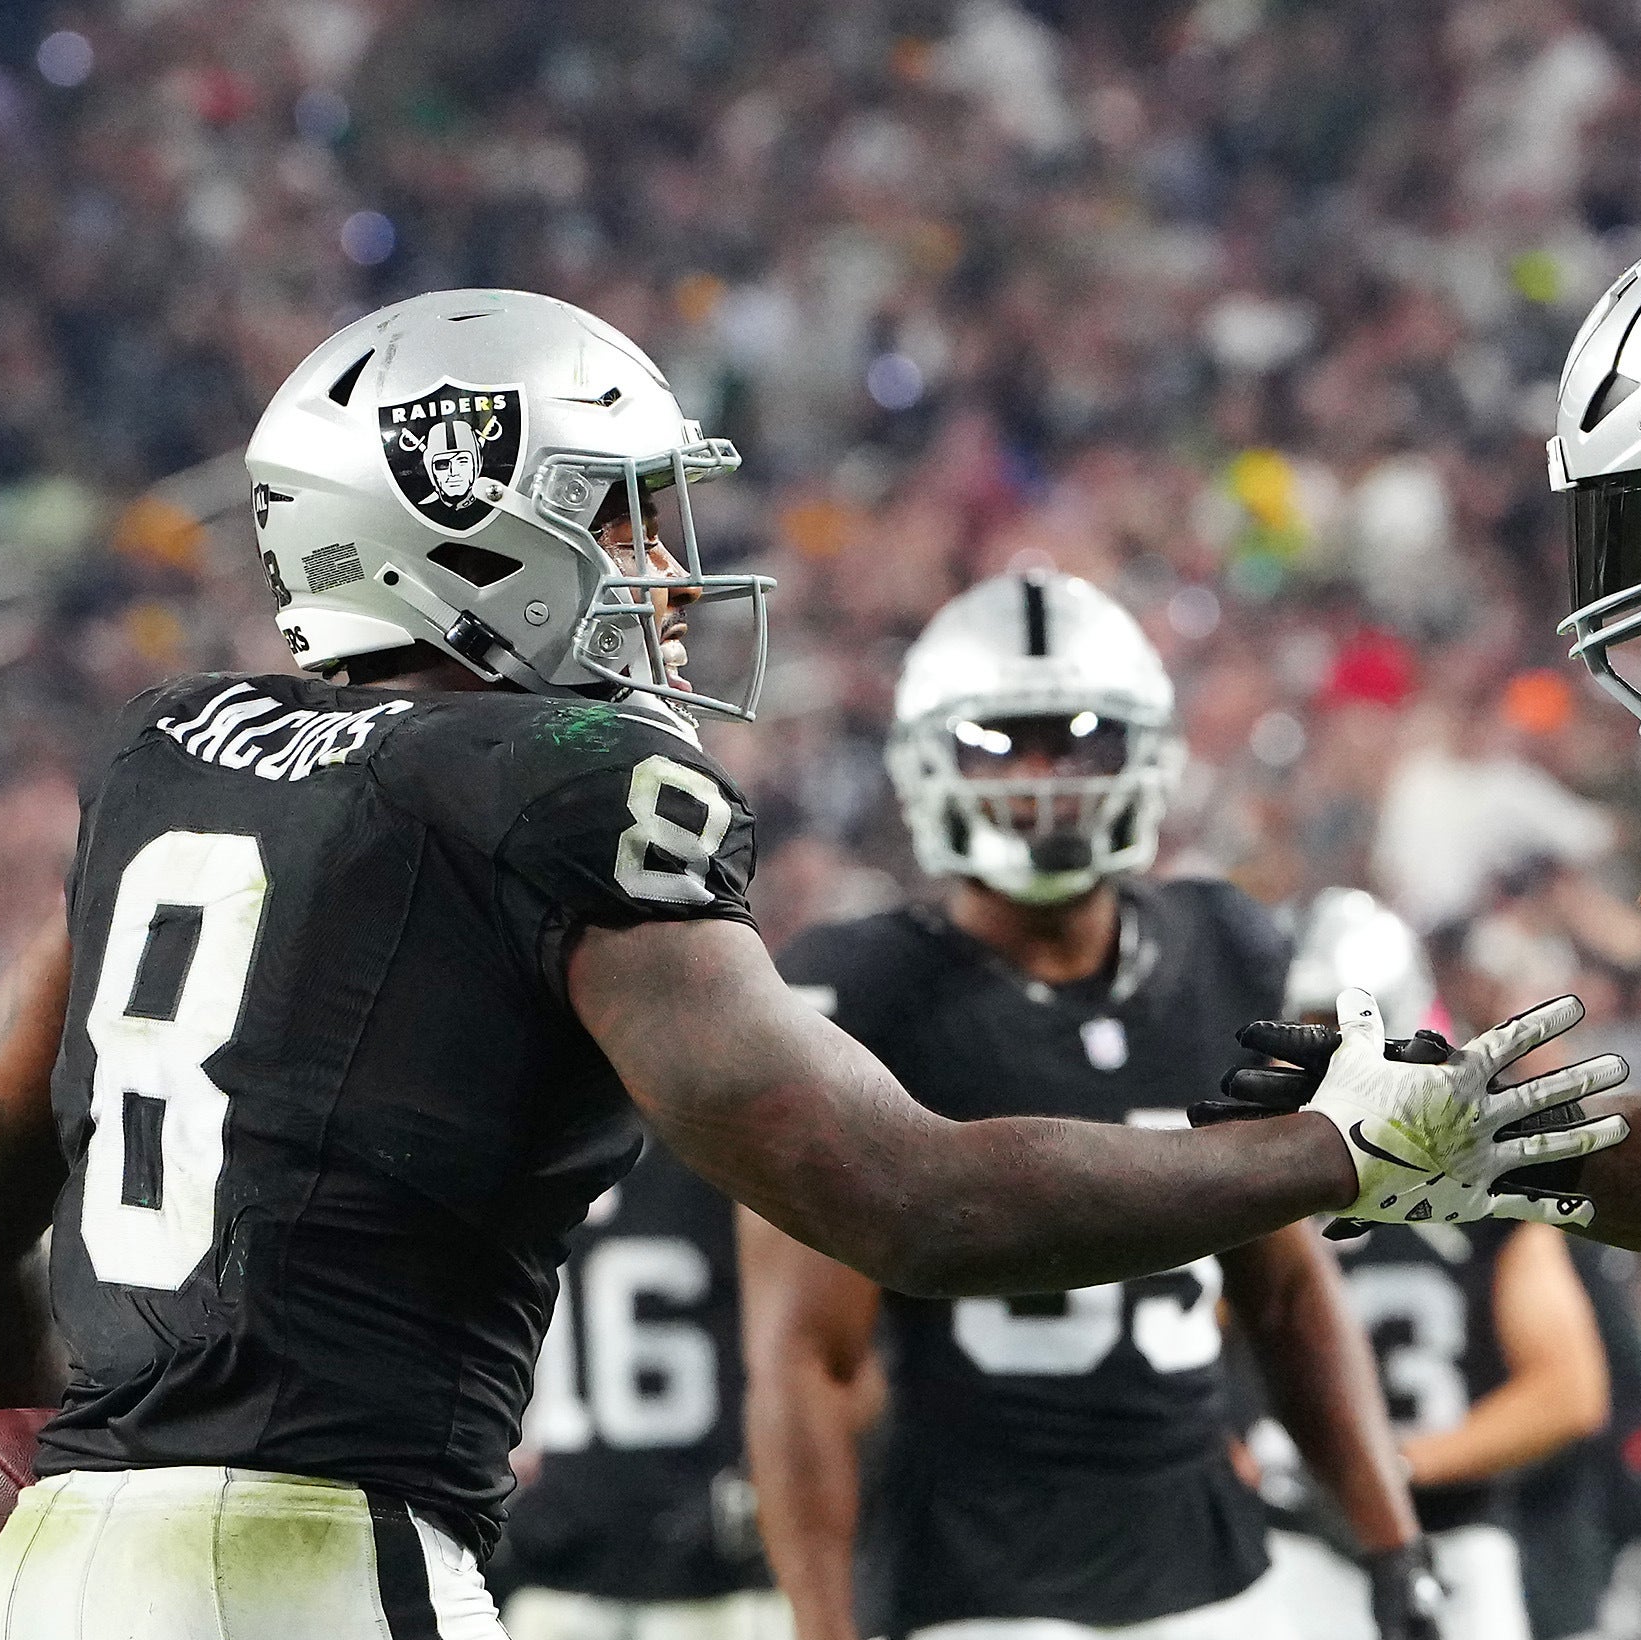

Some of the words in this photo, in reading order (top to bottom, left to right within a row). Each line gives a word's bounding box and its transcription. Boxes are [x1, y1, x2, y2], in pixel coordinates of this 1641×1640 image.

[391, 394, 507, 424] RAIDERS
[156, 681, 415, 782] JACOBS
[613, 753, 732, 906] 8
[80, 830, 268, 1292] 8
[520, 1235, 719, 1451] 16
